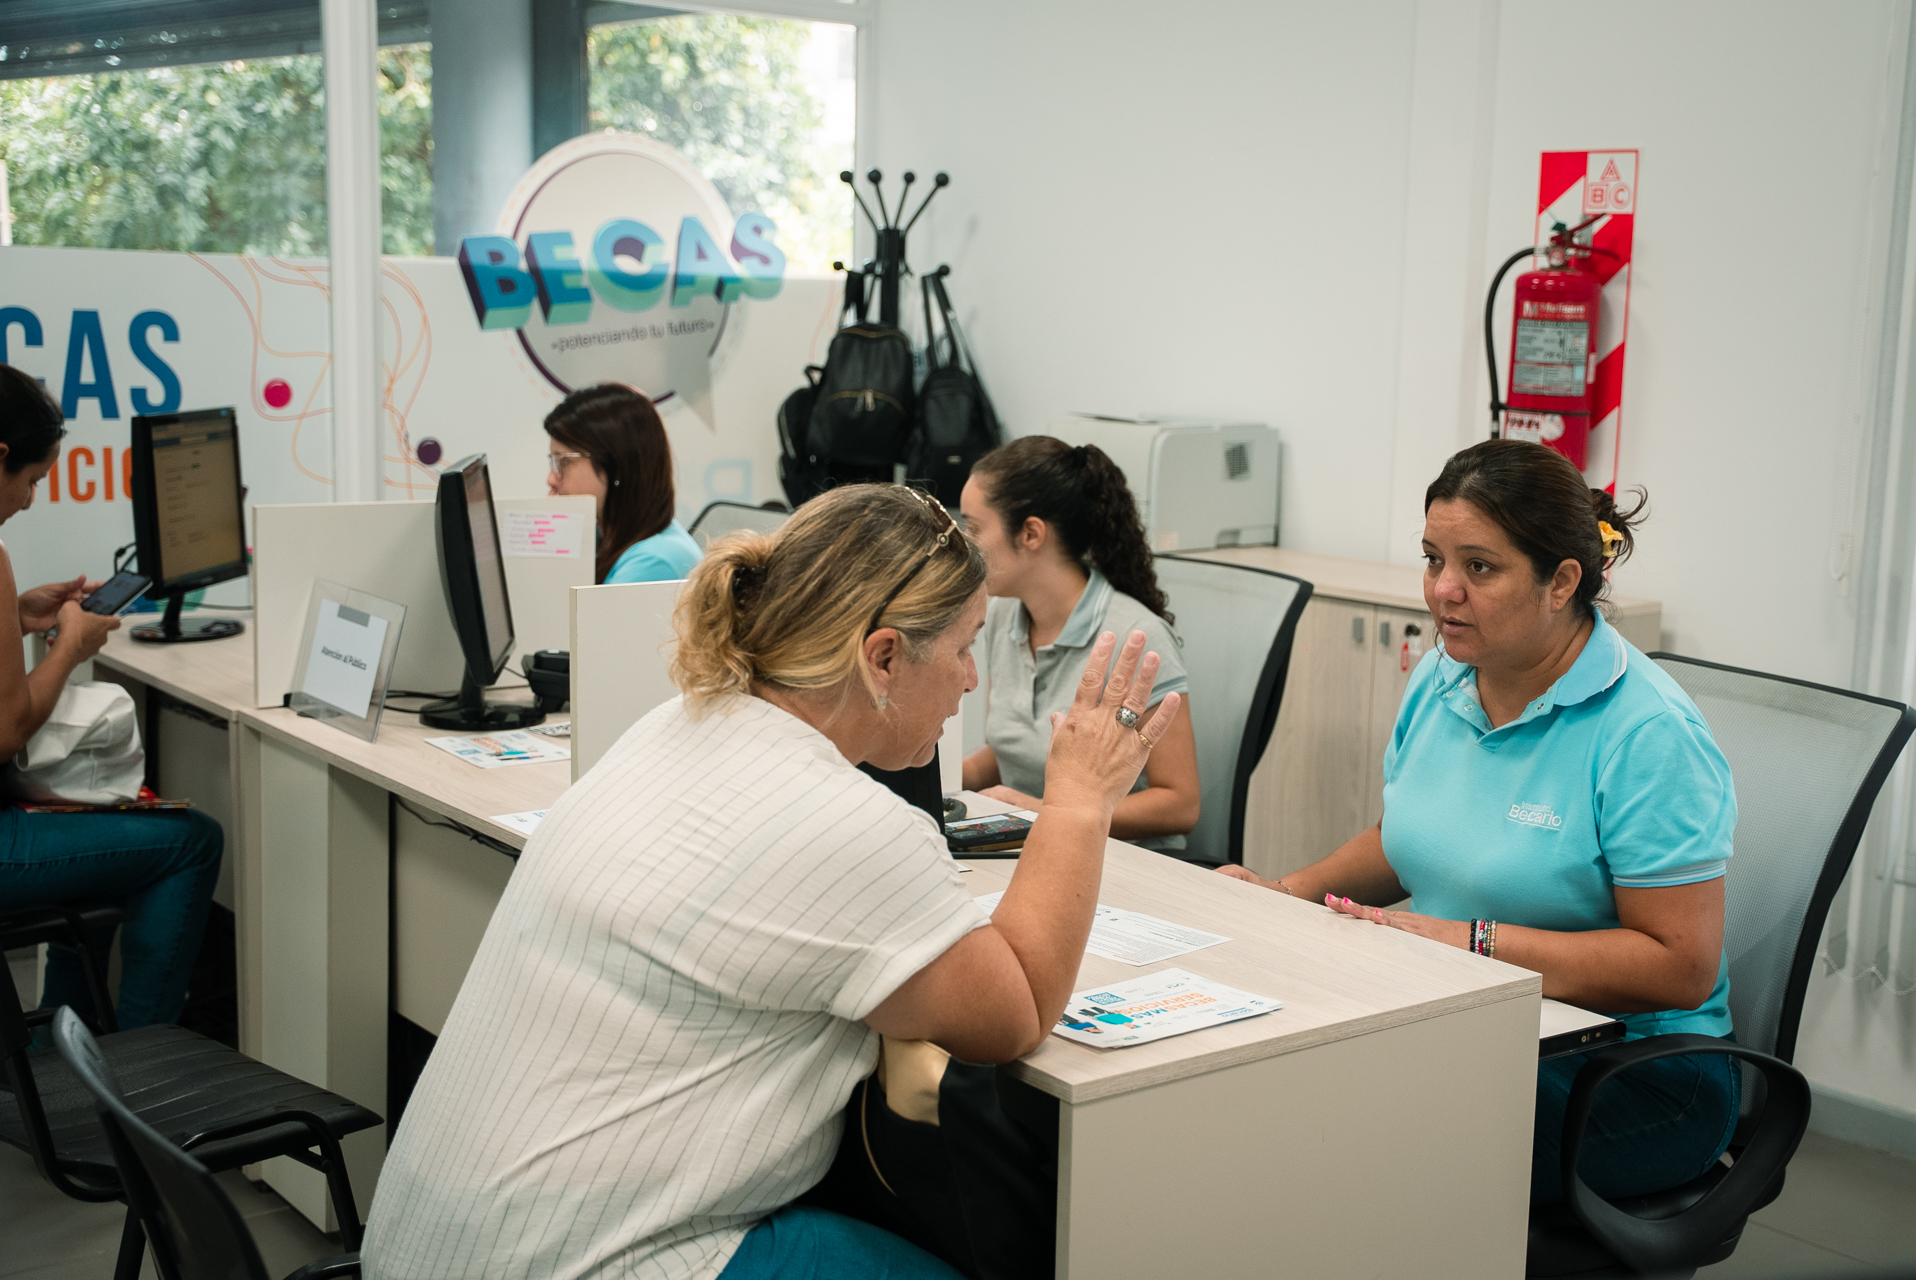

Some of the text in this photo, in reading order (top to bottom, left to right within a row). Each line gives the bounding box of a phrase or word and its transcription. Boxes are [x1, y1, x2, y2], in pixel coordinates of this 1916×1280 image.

[1592, 187, 1625, 205] B C
[458, 212, 787, 331] BECAS
[650, 324, 665, 339] tu
[1508, 803, 1562, 827] Becario
